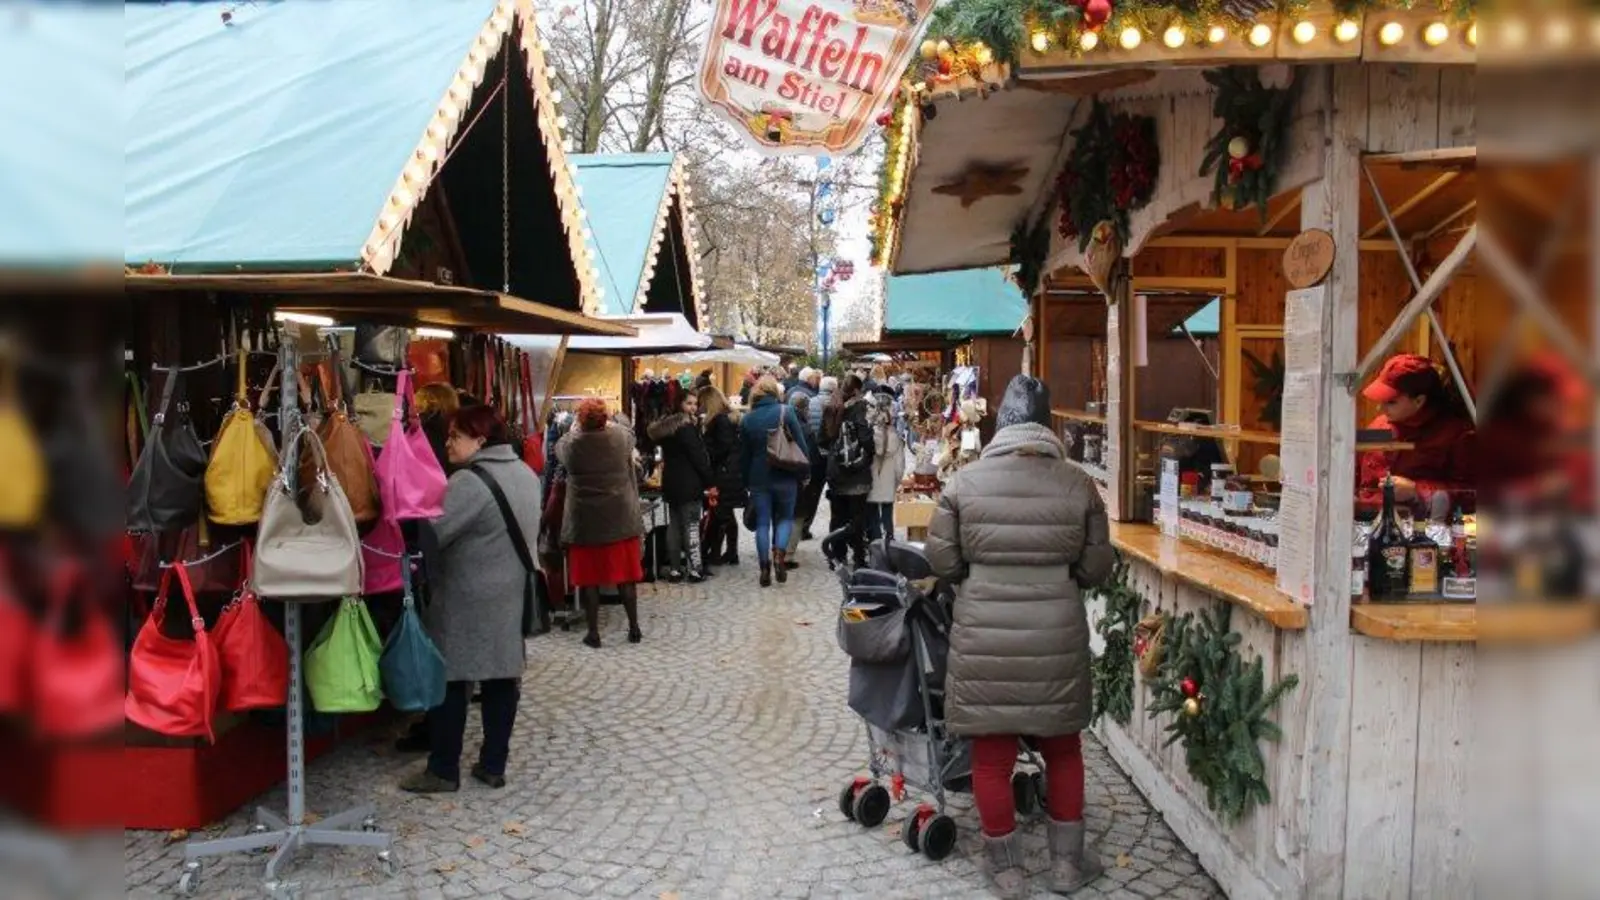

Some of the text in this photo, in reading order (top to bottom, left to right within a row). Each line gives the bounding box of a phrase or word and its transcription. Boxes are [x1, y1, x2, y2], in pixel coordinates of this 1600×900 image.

[722, 0, 883, 95] Waffeln
[724, 55, 847, 119] am Stiel
